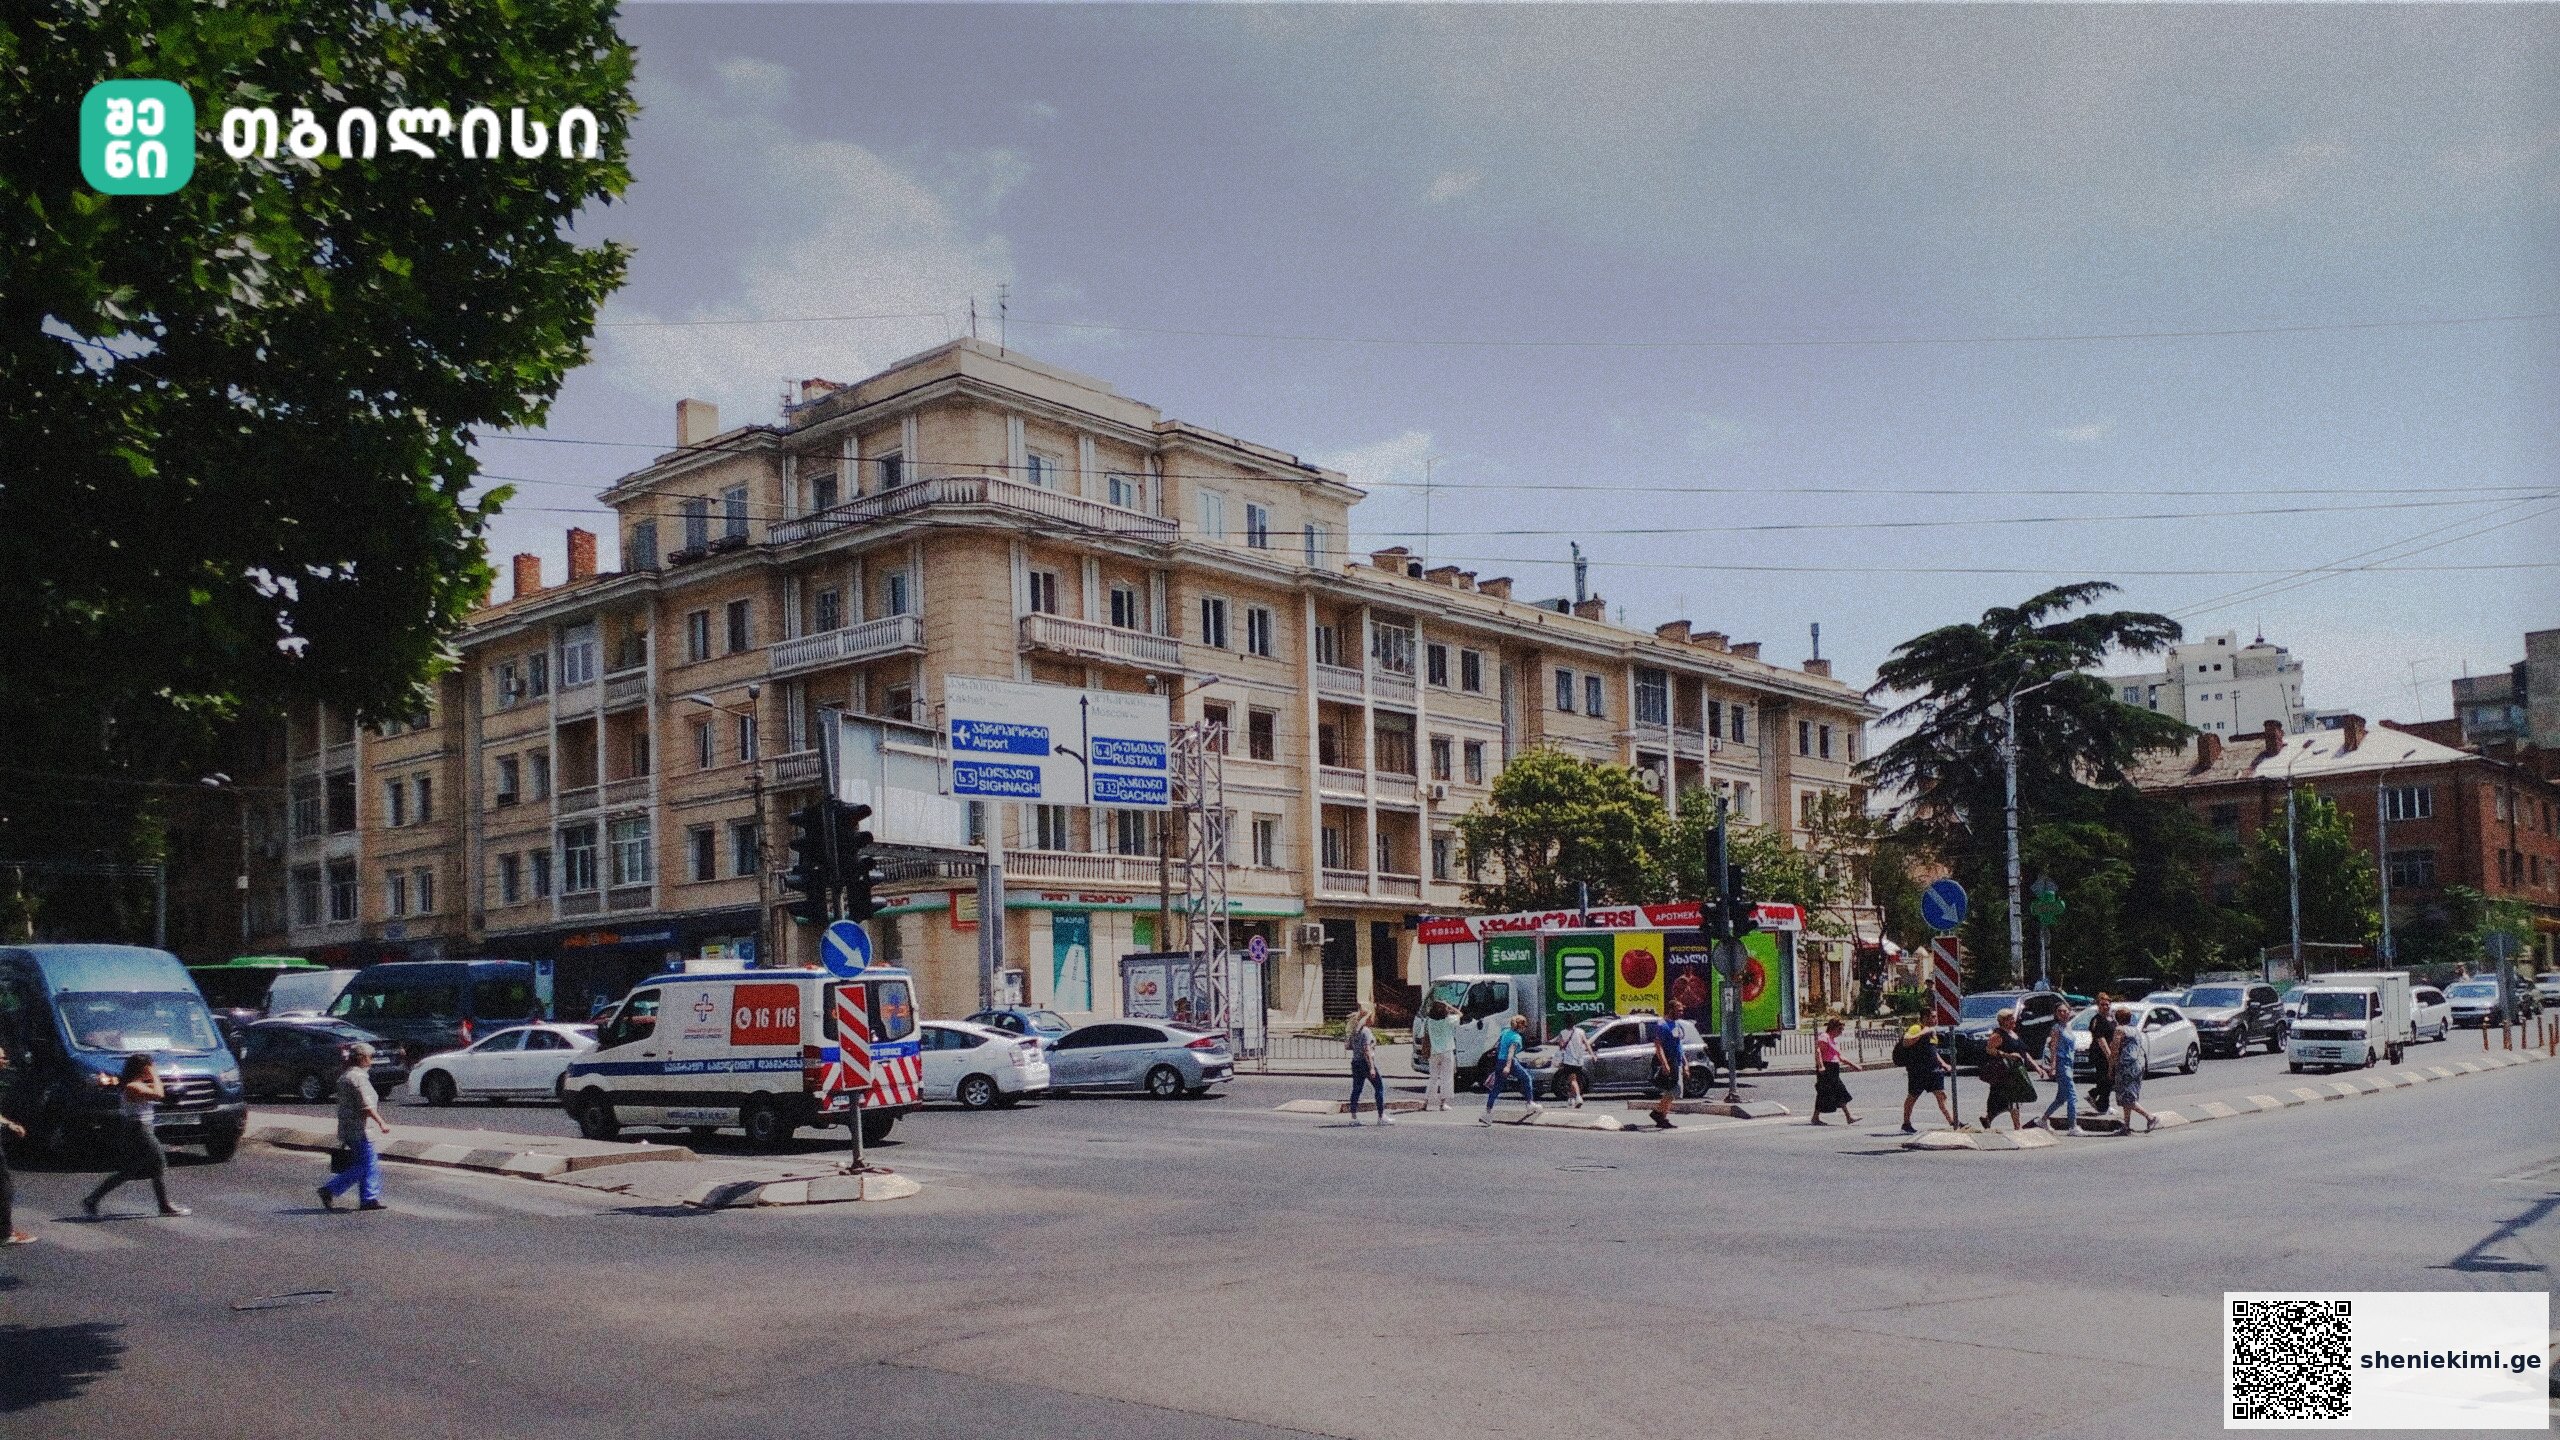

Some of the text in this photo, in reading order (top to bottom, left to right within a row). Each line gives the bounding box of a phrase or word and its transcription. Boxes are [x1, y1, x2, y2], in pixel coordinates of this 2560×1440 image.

[972, 723, 1048, 739] აეროპორტი
[972, 737, 1009, 750] Airport
[1112, 742, 1166, 755] რუსთავი
[1112, 754, 1158, 766] RUSTAVI
[978, 767, 1034, 781] სიღნაღი
[978, 779, 1041, 793] SIGHNAGHI
[1106, 782, 1117, 793] 32
[1668, 953, 1709, 964] ახალი
[1556, 1001, 1605, 1013] ნაბიჯი
[755, 1006, 797, 1027] 16 116
